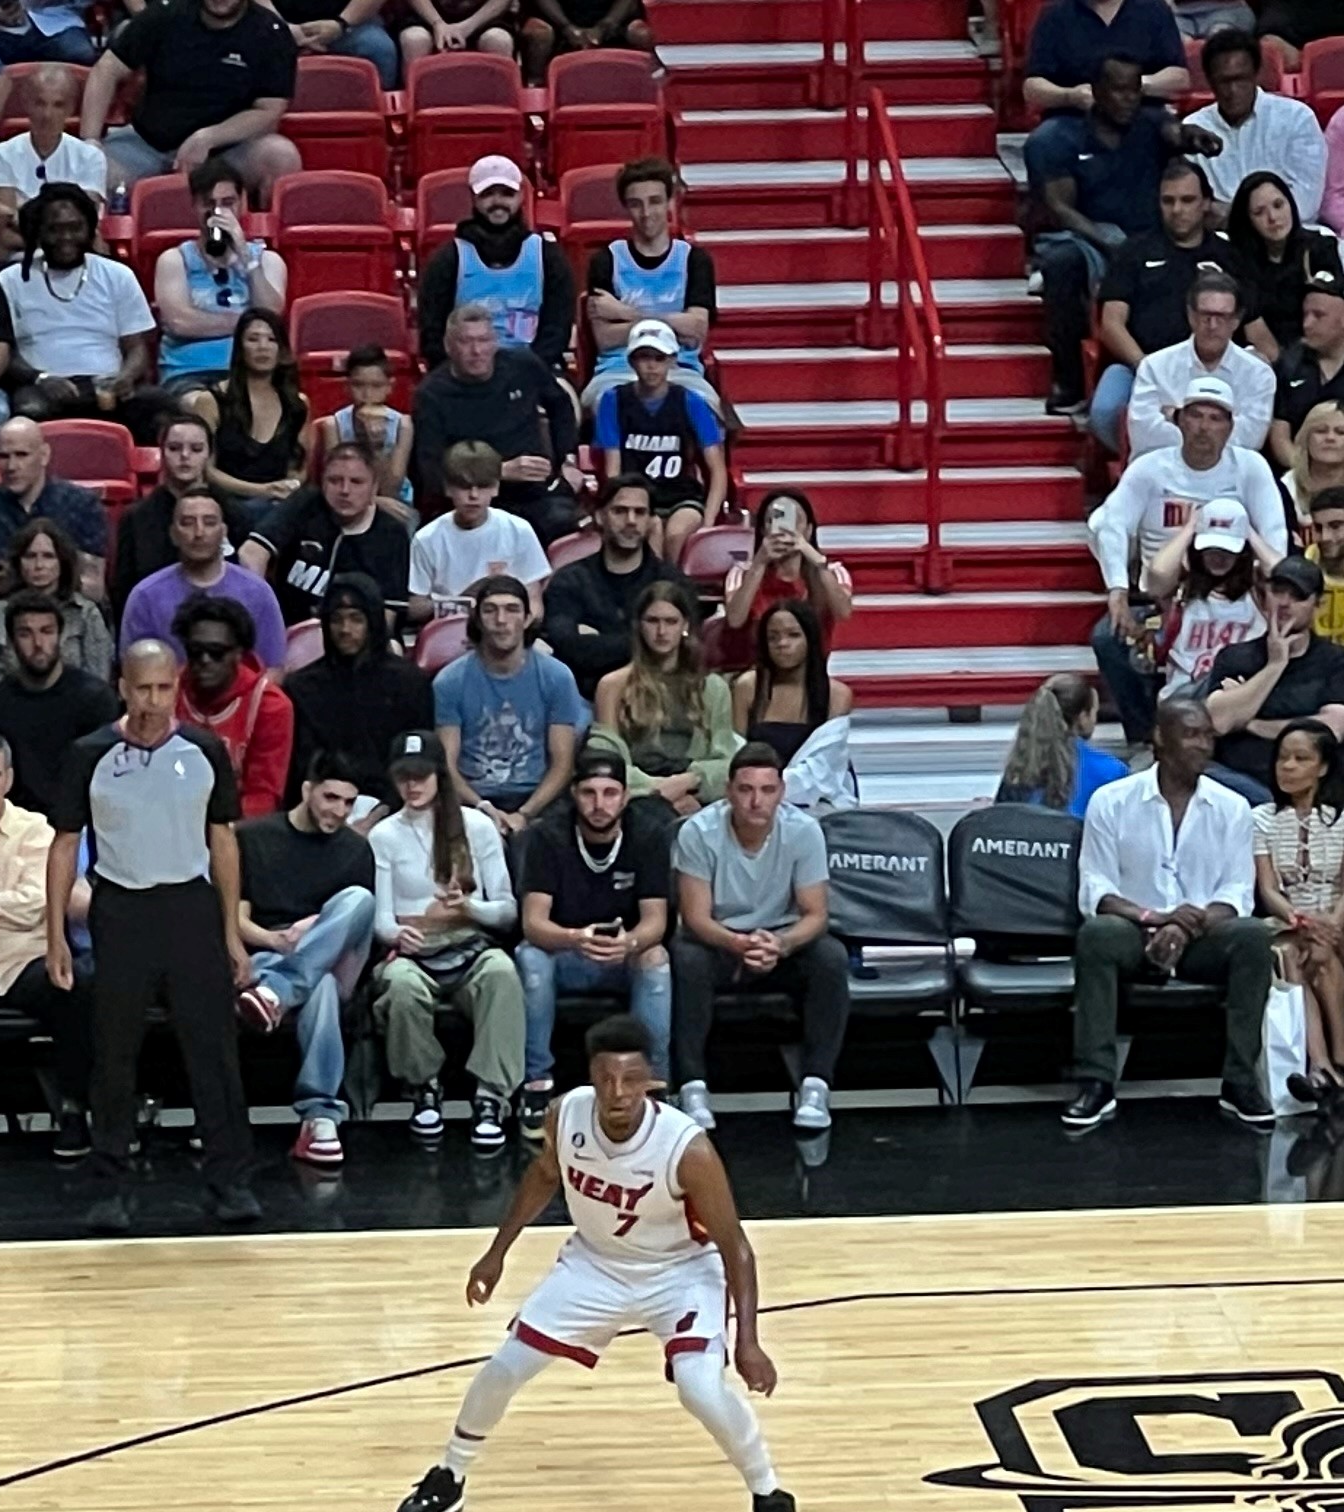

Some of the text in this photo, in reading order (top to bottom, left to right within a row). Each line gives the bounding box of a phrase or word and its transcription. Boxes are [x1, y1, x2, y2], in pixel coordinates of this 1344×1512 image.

[645, 455, 682, 478] 40
[971, 837, 1071, 860] AMERANT
[829, 853, 929, 873] AMERANT
[567, 1165, 654, 1211] HEAT
[613, 1213, 640, 1237] 7
